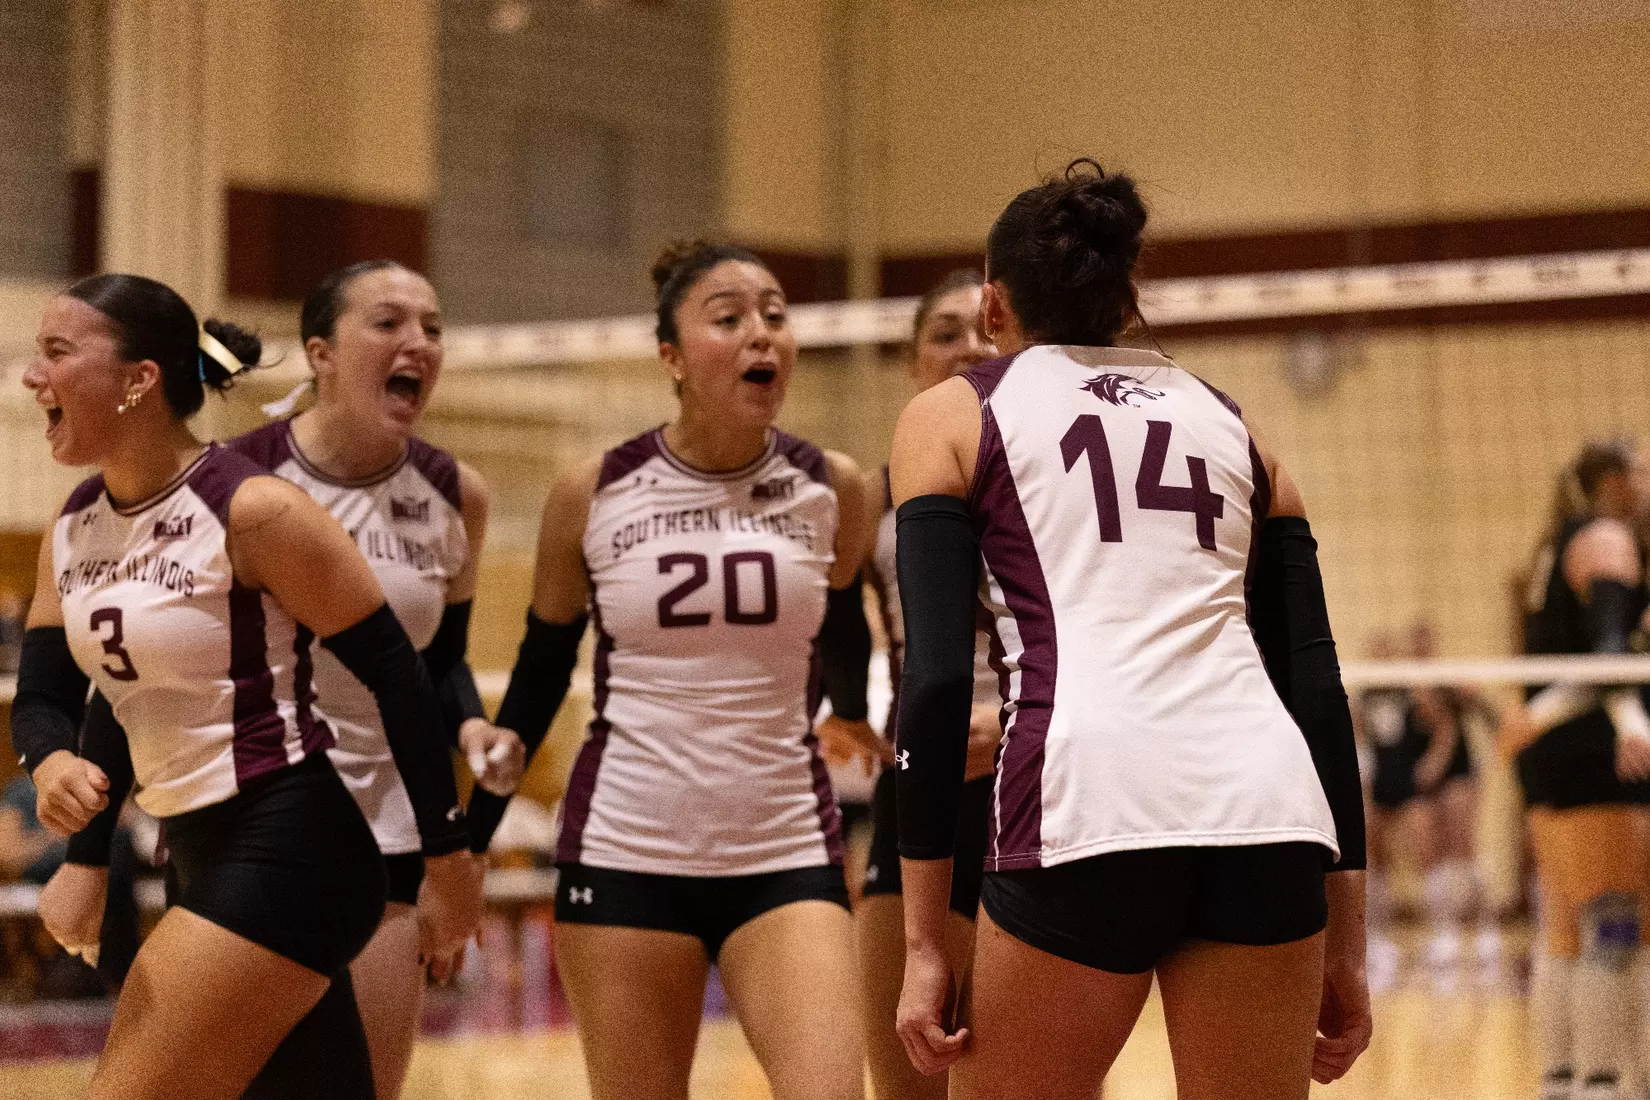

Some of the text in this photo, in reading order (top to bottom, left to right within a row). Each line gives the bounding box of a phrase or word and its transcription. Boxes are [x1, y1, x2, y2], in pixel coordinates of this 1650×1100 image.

[1059, 413, 1225, 552] 14
[611, 508, 721, 559] SOUTHERN
[657, 551, 779, 628] 20
[90, 606, 139, 681] 3
